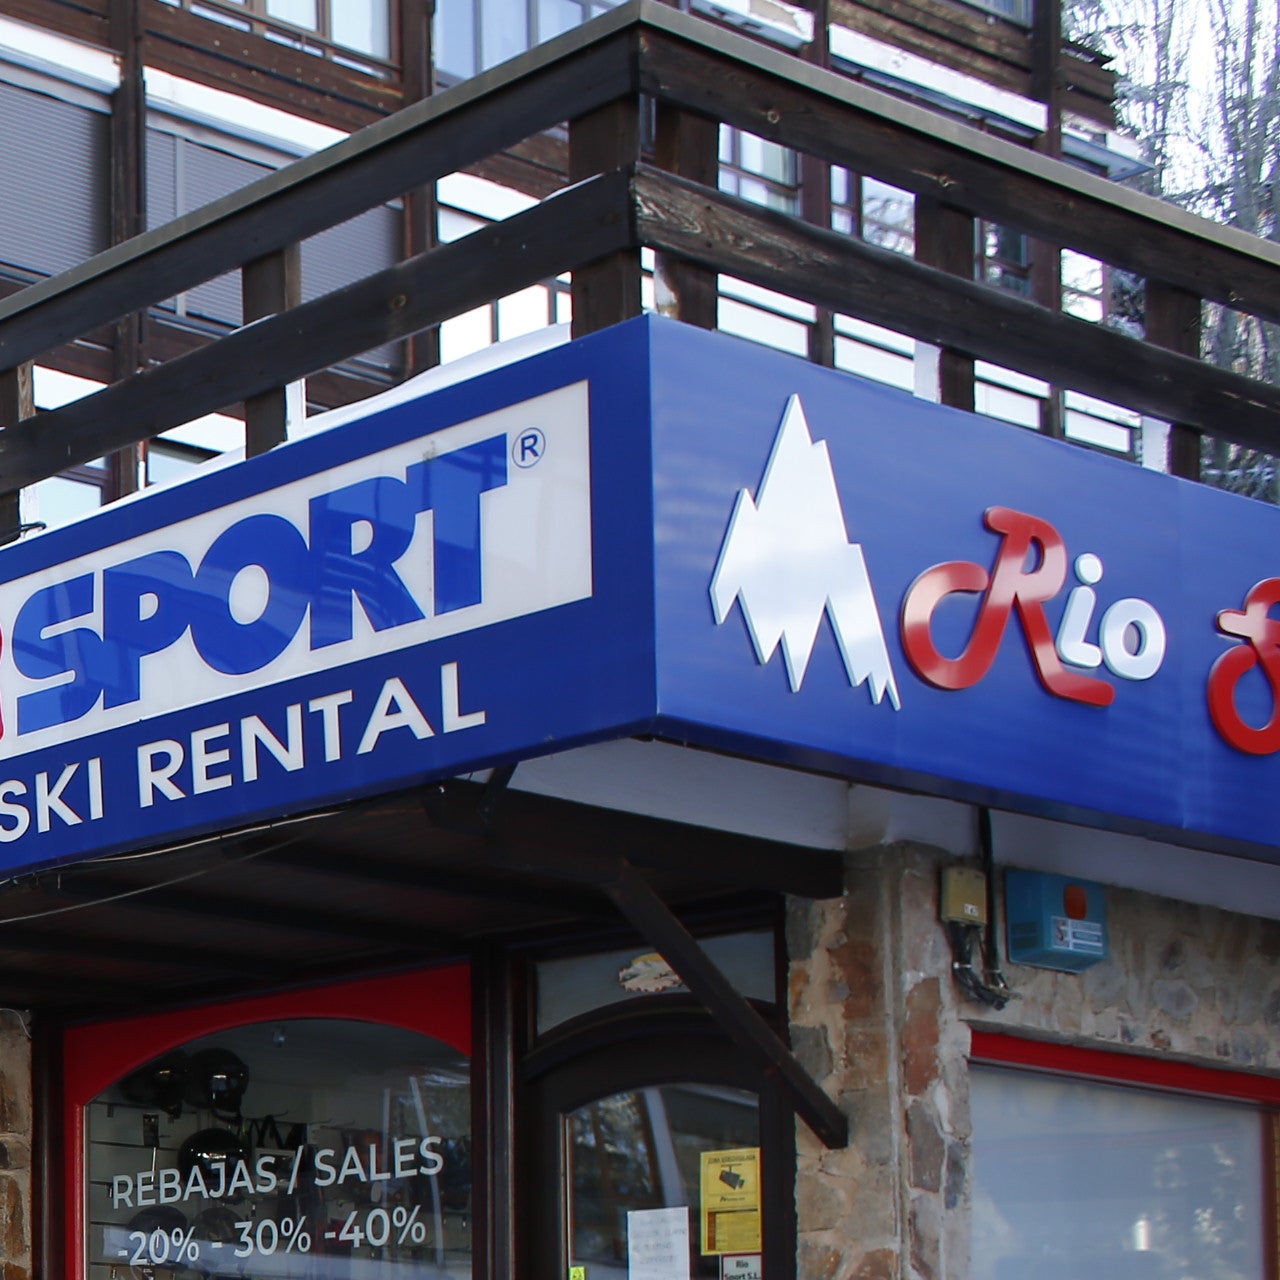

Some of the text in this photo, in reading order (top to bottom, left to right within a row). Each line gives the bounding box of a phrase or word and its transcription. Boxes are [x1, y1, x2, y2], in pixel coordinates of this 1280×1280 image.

[901, 506, 1167, 707] Rio
[137, 661, 486, 808] RENTAL
[112, 1136, 444, 1210] REBAJAS / SALES
[323, 1204, 427, 1249] -40%
